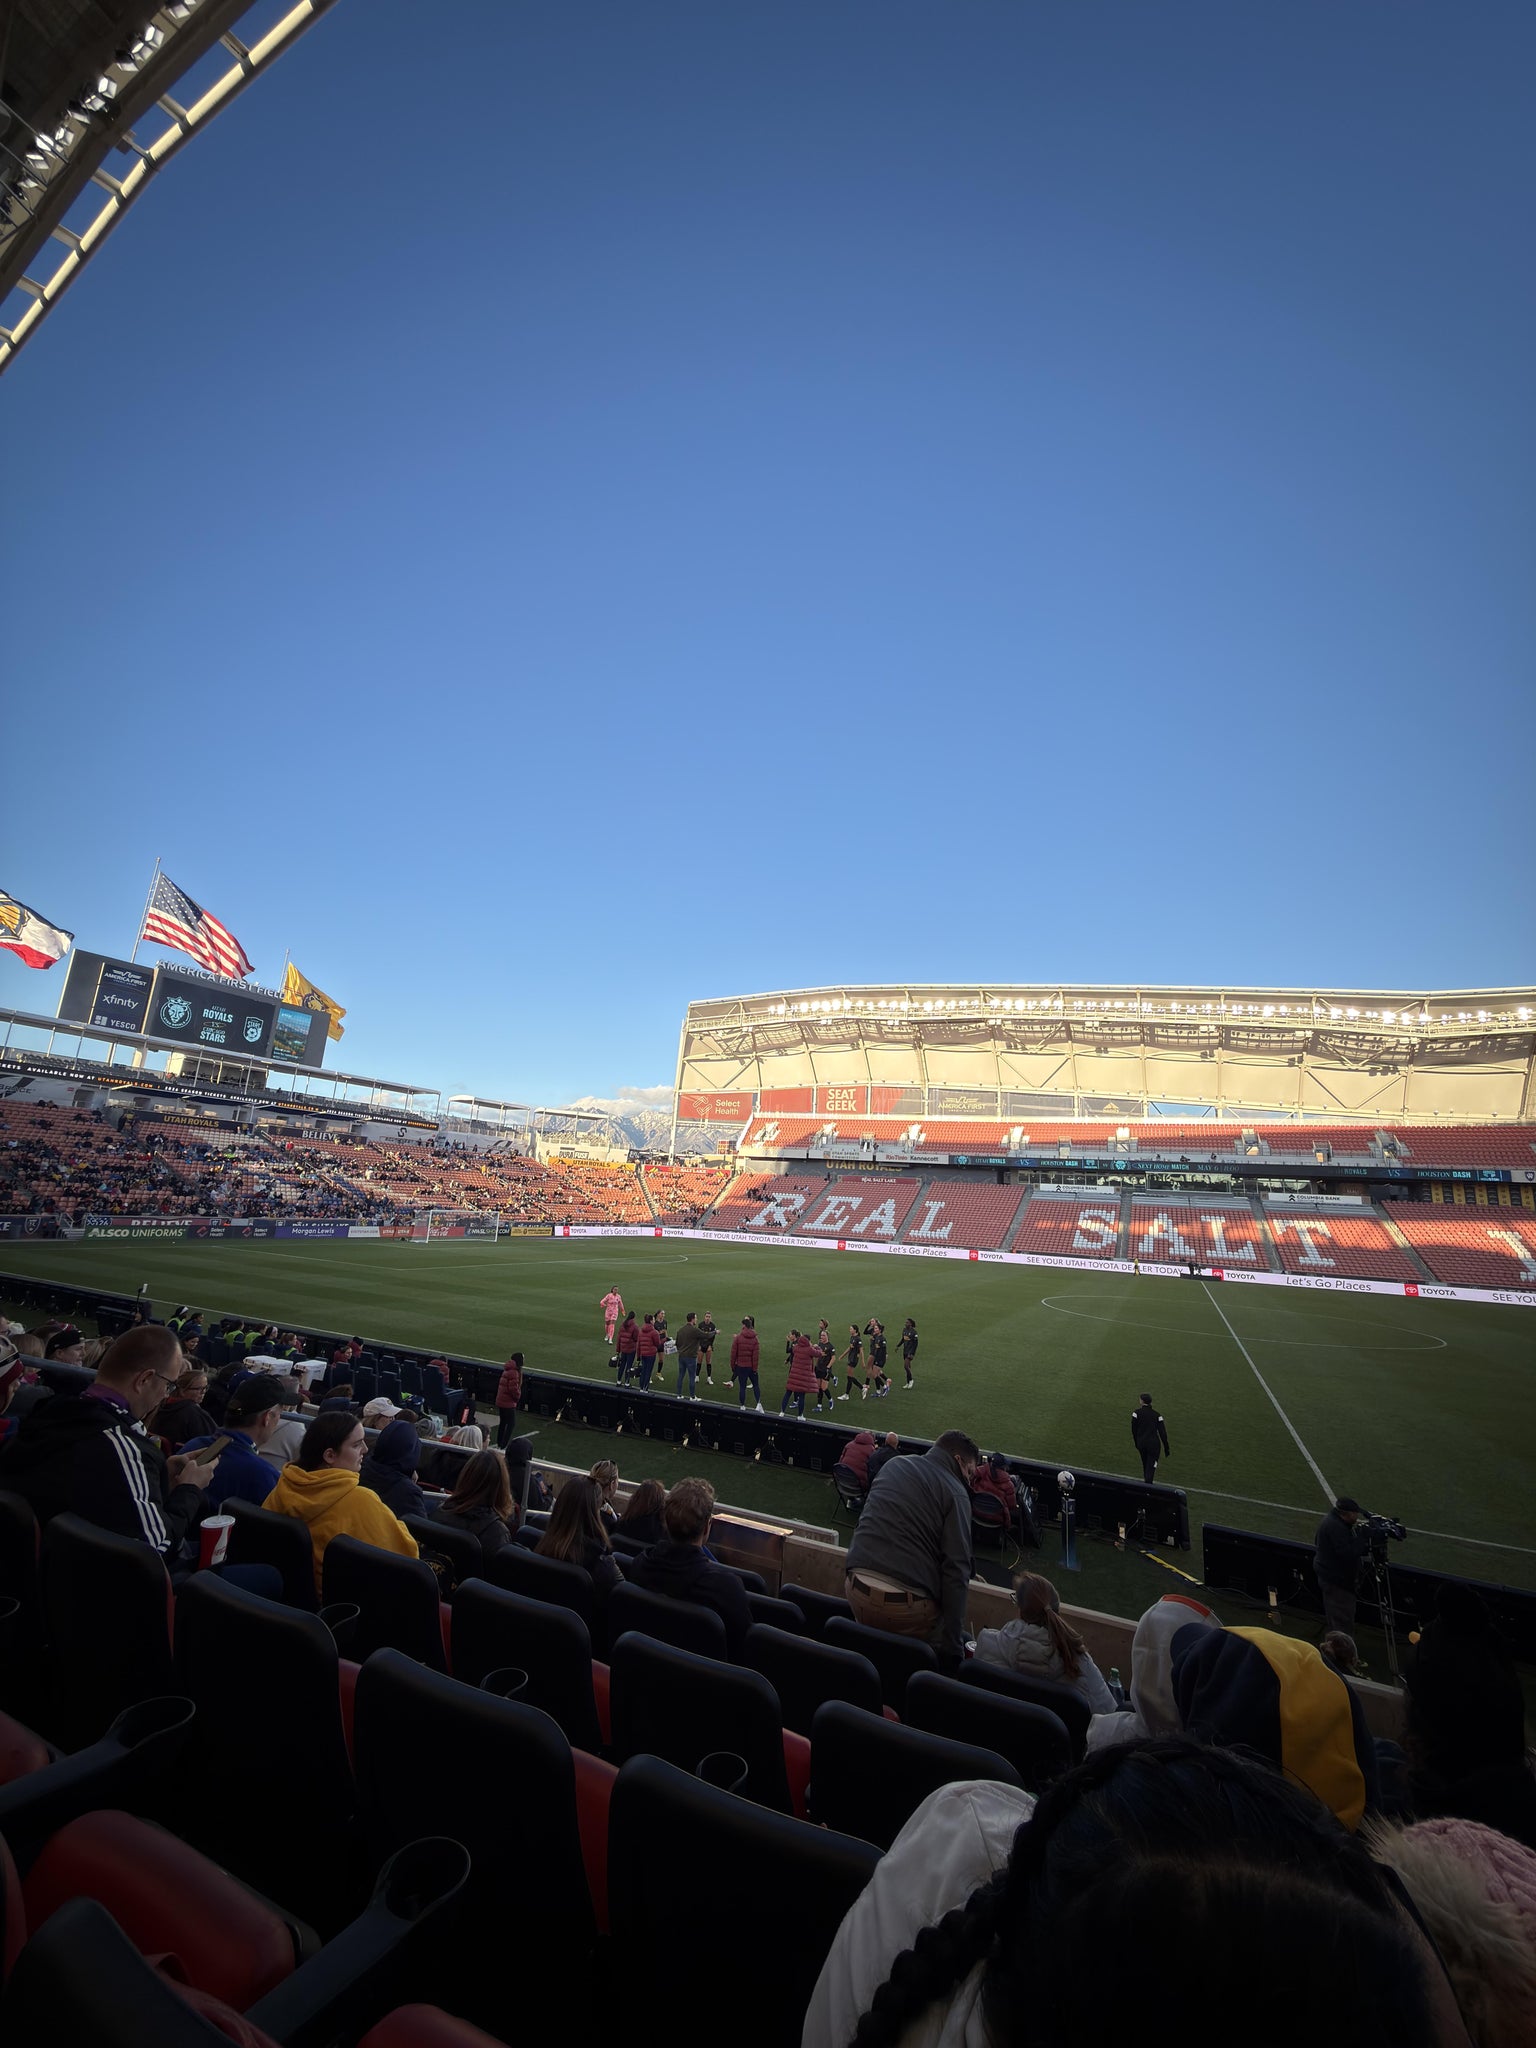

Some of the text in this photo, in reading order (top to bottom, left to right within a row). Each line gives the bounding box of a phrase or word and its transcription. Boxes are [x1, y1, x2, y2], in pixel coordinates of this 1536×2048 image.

[104, 972, 130, 983] AMERICA
[129, 978, 147, 987] FIRST
[157, 960, 285, 999] AMERICA FIRST FIELD
[102, 994, 139, 1009] xfinity
[202, 1008, 234, 1023] ROYALS
[110, 1019, 136, 1030] YESCO
[199, 1030, 226, 1044] STARS
[27, 1066, 67, 1077] AVAILABLE
[827, 1088, 856, 1100] SEAT
[715, 1099, 741, 1107] Select
[825, 1100, 857, 1111] GEEK
[938, 1102, 967, 1110] AMERICA
[715, 1107, 739, 1115] Health
[163, 1115, 219, 1127] UTAH ROYALS
[826, 1160, 856, 1170] UTAH
[1019, 1158, 1030, 1166] VS
[1343, 1167, 1368, 1175] ROYALS
[1387, 1169, 1401, 1177] VS
[1452, 1171, 1471, 1179] DASH
[88, 1227, 184, 1238] ALSCO UNIFORMS
[291, 1228, 317, 1236] Morgan
[600, 1227, 639, 1235] Let's Go Places
[748, 1192, 1336, 1268] REAL SALT
[713, 1232, 730, 1240] YOUR
[730, 1233, 748, 1241] UTAH
[748, 1235, 772, 1243] TOYOTA
[772, 1237, 796, 1245] DEALER
[888, 1245, 948, 1257] Let's Go Places
[1041, 1257, 1064, 1266] YOUR
[1065, 1259, 1086, 1267] UTAH
[1088, 1261, 1120, 1271] TOYOTA
[1154, 1266, 1184, 1275] TODAY
[1226, 1272, 1256, 1281] TOYOTA
[1286, 1276, 1372, 1292] Let's Go Places
[1421, 1287, 1457, 1296] TOYOTA
[1492, 1293, 1512, 1302] SEE
